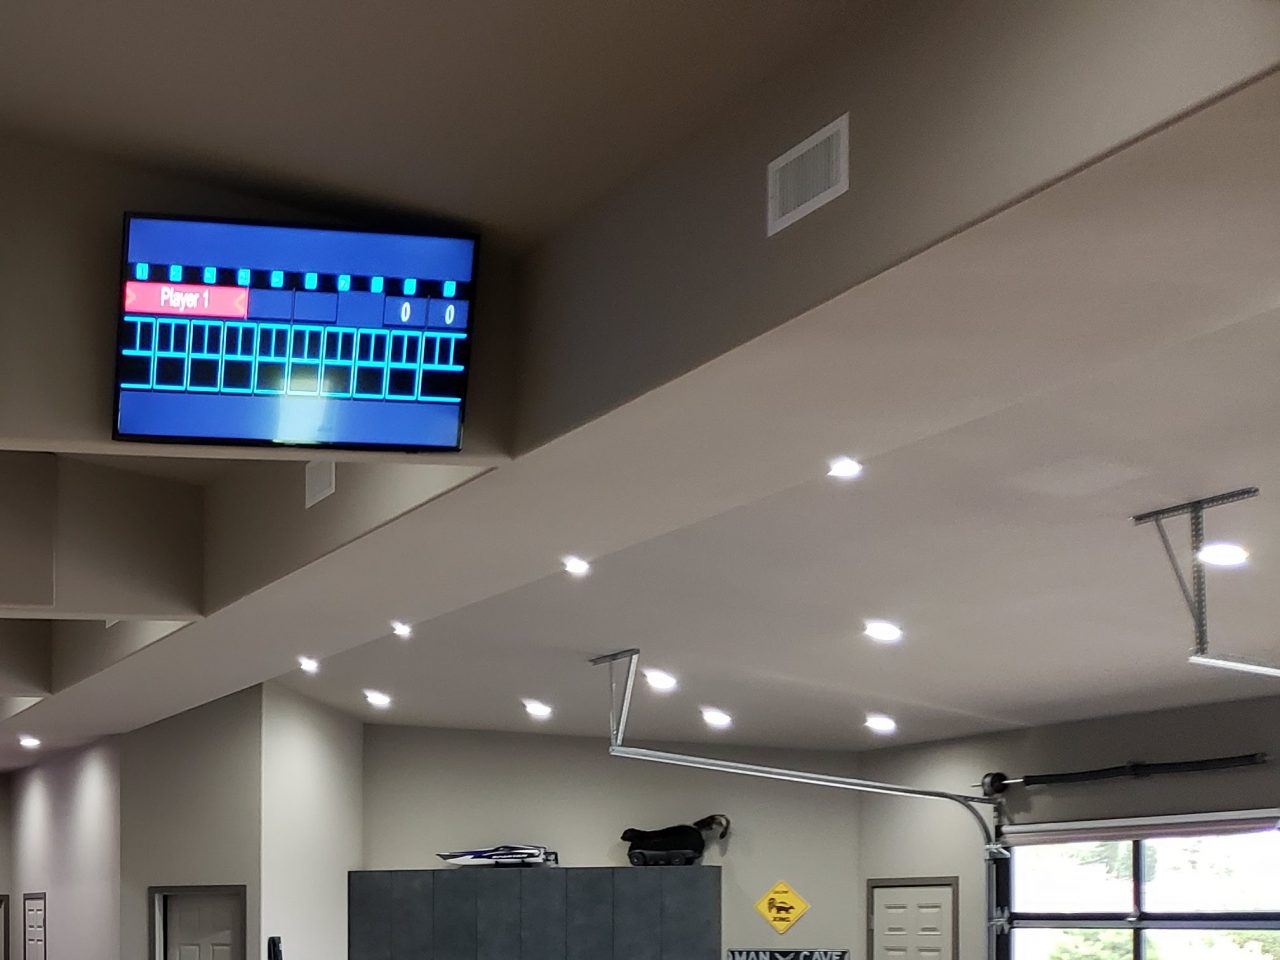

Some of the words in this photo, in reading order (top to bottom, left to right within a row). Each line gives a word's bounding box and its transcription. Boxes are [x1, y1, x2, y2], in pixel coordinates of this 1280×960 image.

[160, 286, 199, 312] Player
[203, 288, 210, 308] 1
[400, 301, 411, 322] 0
[445, 304, 455, 325] 0
